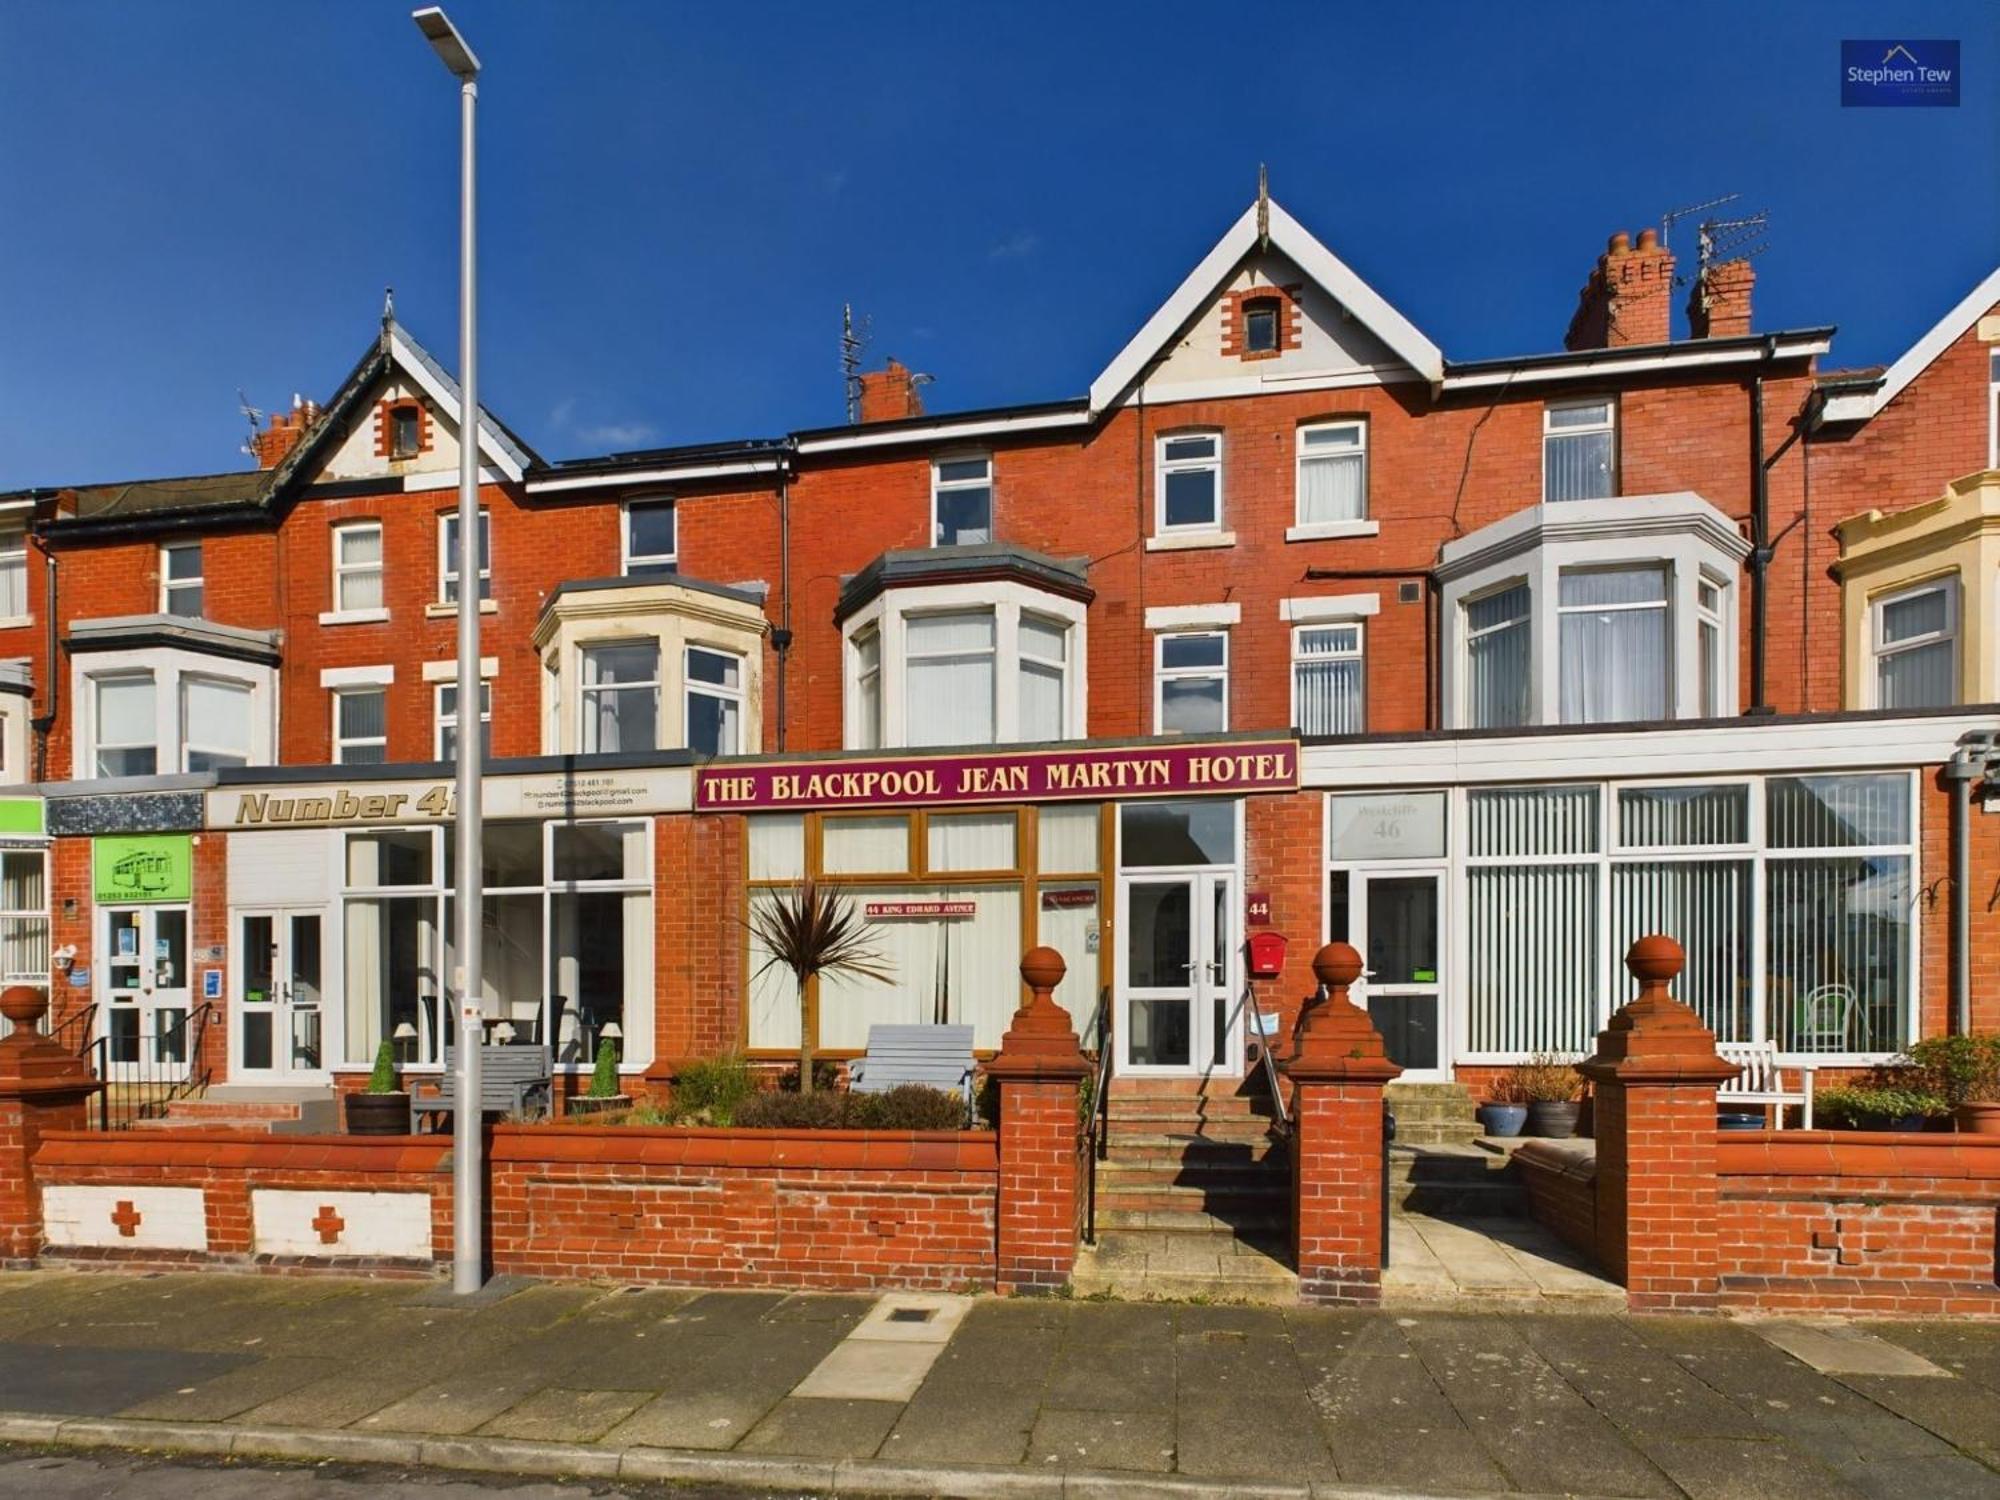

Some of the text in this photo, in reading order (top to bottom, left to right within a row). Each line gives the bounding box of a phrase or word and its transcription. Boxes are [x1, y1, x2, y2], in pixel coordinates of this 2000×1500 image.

[704, 753, 1293, 802] THE BLACKPOOL JEAN MARTYN HOTEL
[235, 786, 456, 824] Number 4
[1373, 819, 1401, 839] 46
[867, 904, 974, 914] 44 KING EDWARD AVENUE
[1249, 903, 1268, 915] 44
